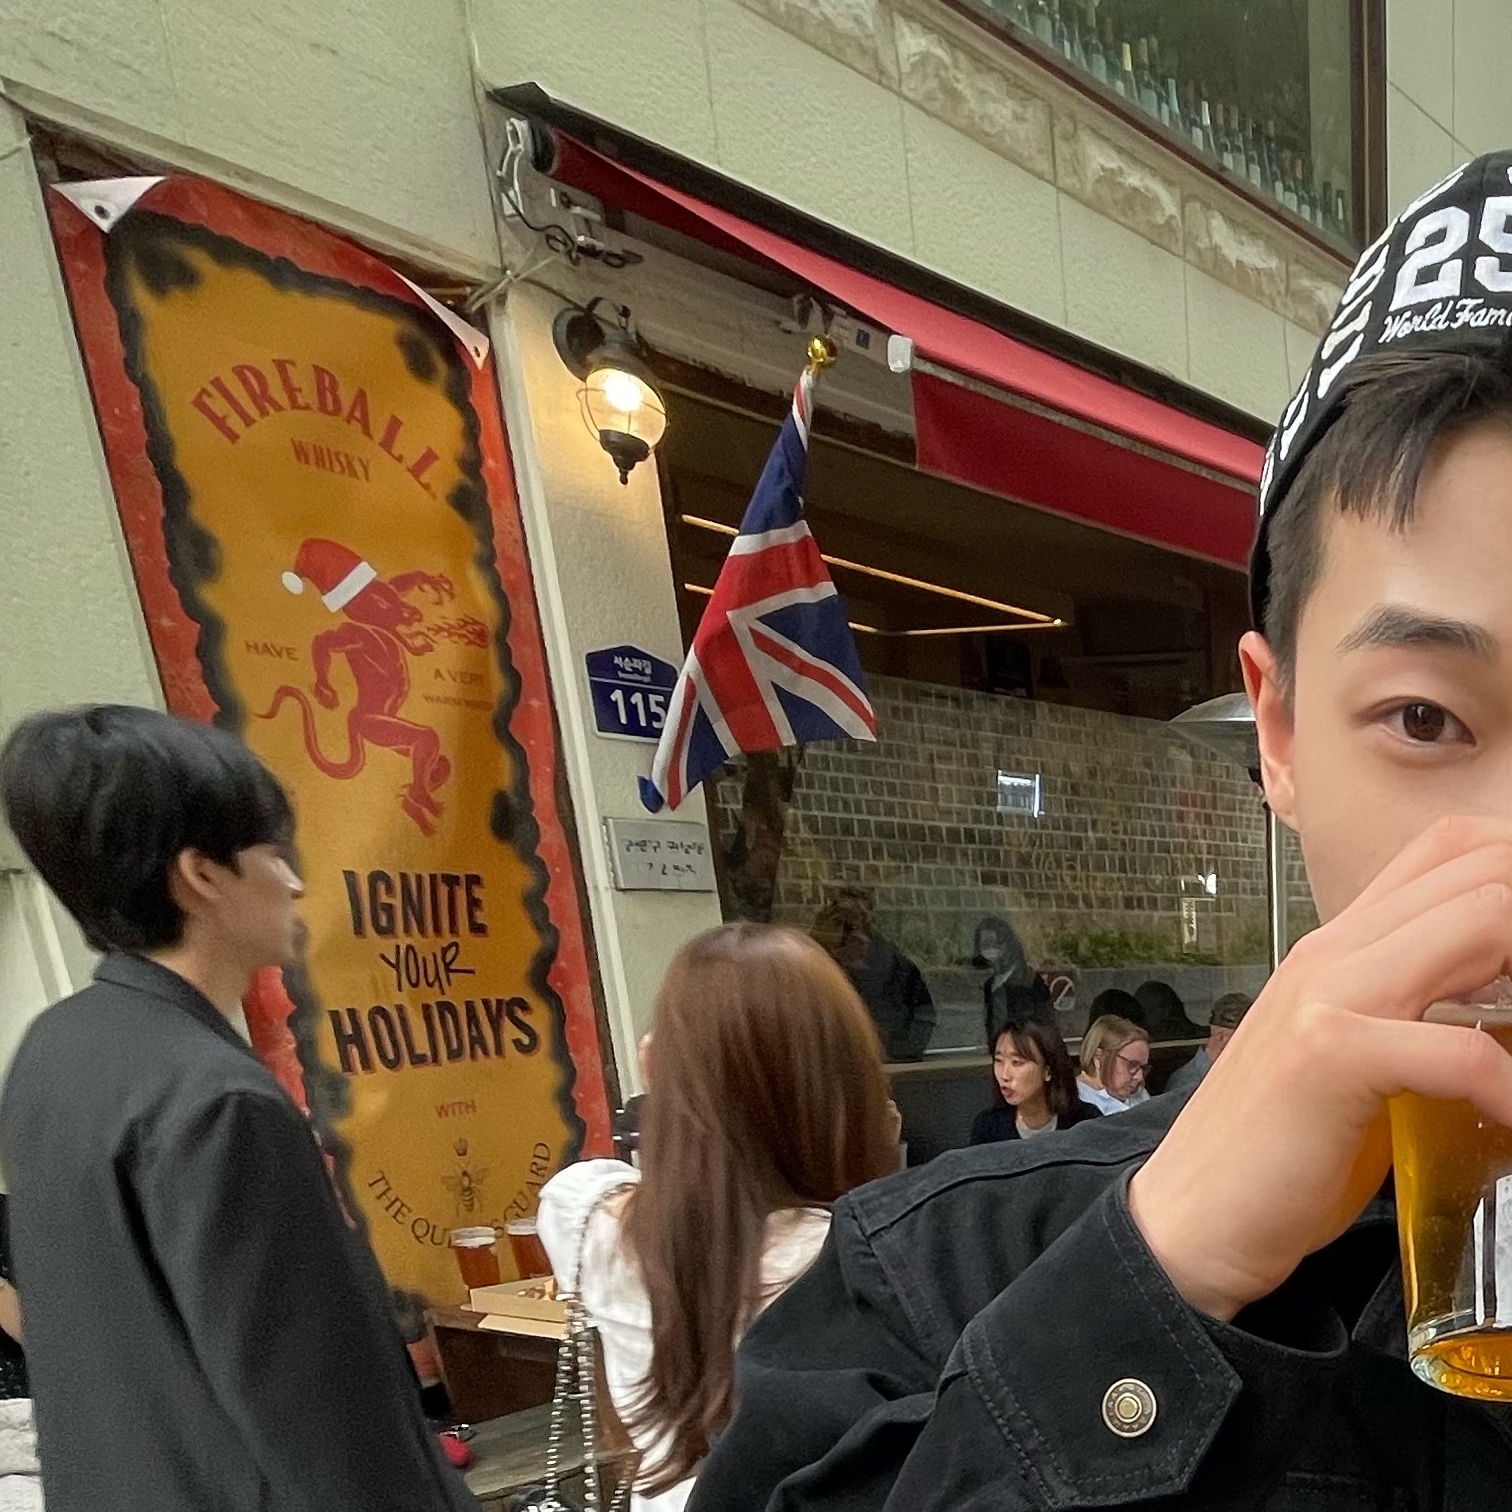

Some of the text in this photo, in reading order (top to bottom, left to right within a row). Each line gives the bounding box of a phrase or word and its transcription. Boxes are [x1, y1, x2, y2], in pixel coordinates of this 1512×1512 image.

[1377, 300, 1453, 343] World
[191, 358, 440, 501] FIREBALL
[290, 437, 371, 483] WHISKY
[243, 639, 300, 662] HAVE
[433, 668, 447, 682] A
[609, 689, 668, 729] 115
[342, 869, 488, 939] IGNITE
[379, 940, 476, 996] YOUR
[327, 996, 541, 1075] HOLIDAYS
[435, 1100, 478, 1119] WITH
[366, 1169, 413, 1226] THE
